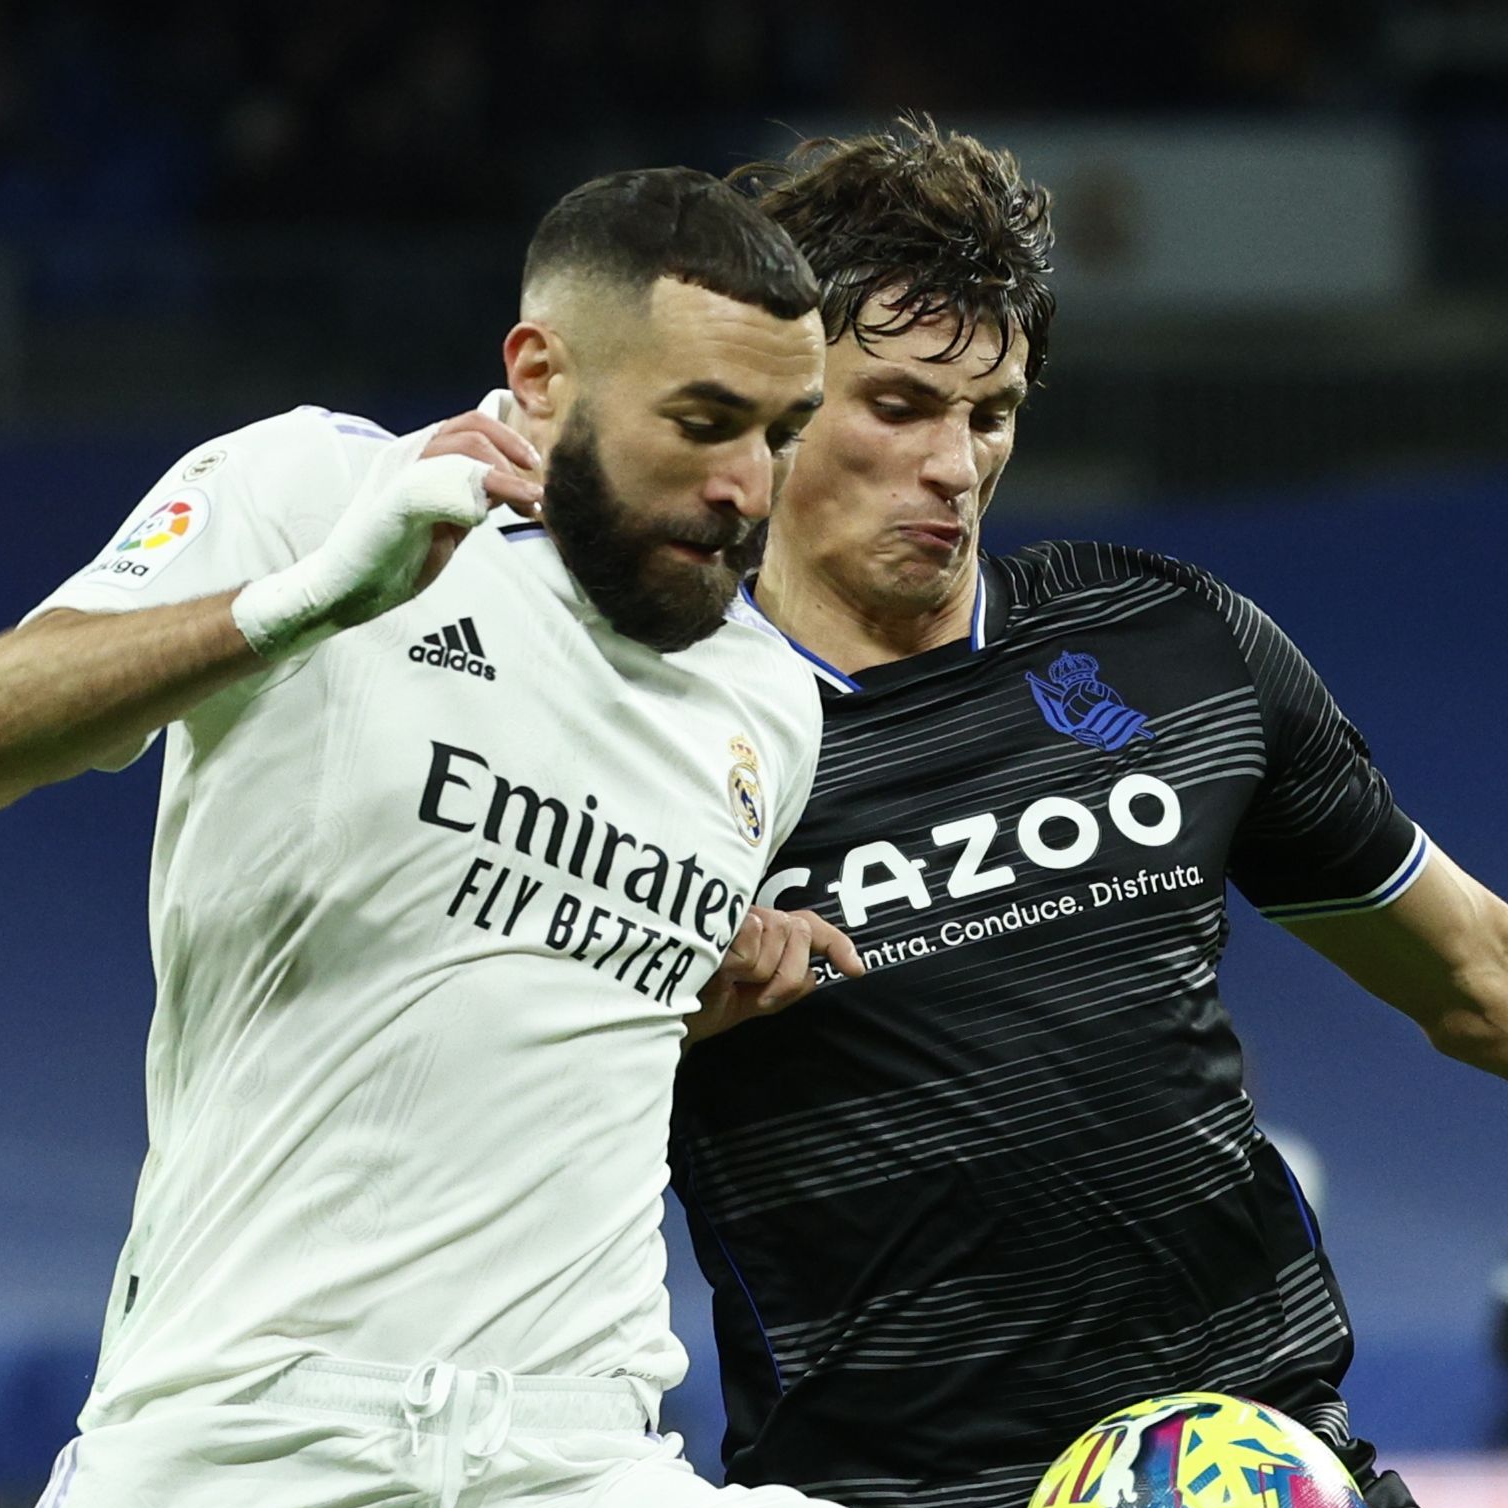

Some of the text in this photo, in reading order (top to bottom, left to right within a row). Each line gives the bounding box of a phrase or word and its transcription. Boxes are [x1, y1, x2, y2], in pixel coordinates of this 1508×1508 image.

[408, 642, 497, 682] adidas
[418, 739, 745, 954] Emirates
[447, 857, 697, 1008] FLY BETTER
[811, 864, 1204, 986] cuntra. Conduce. Disfruta.
